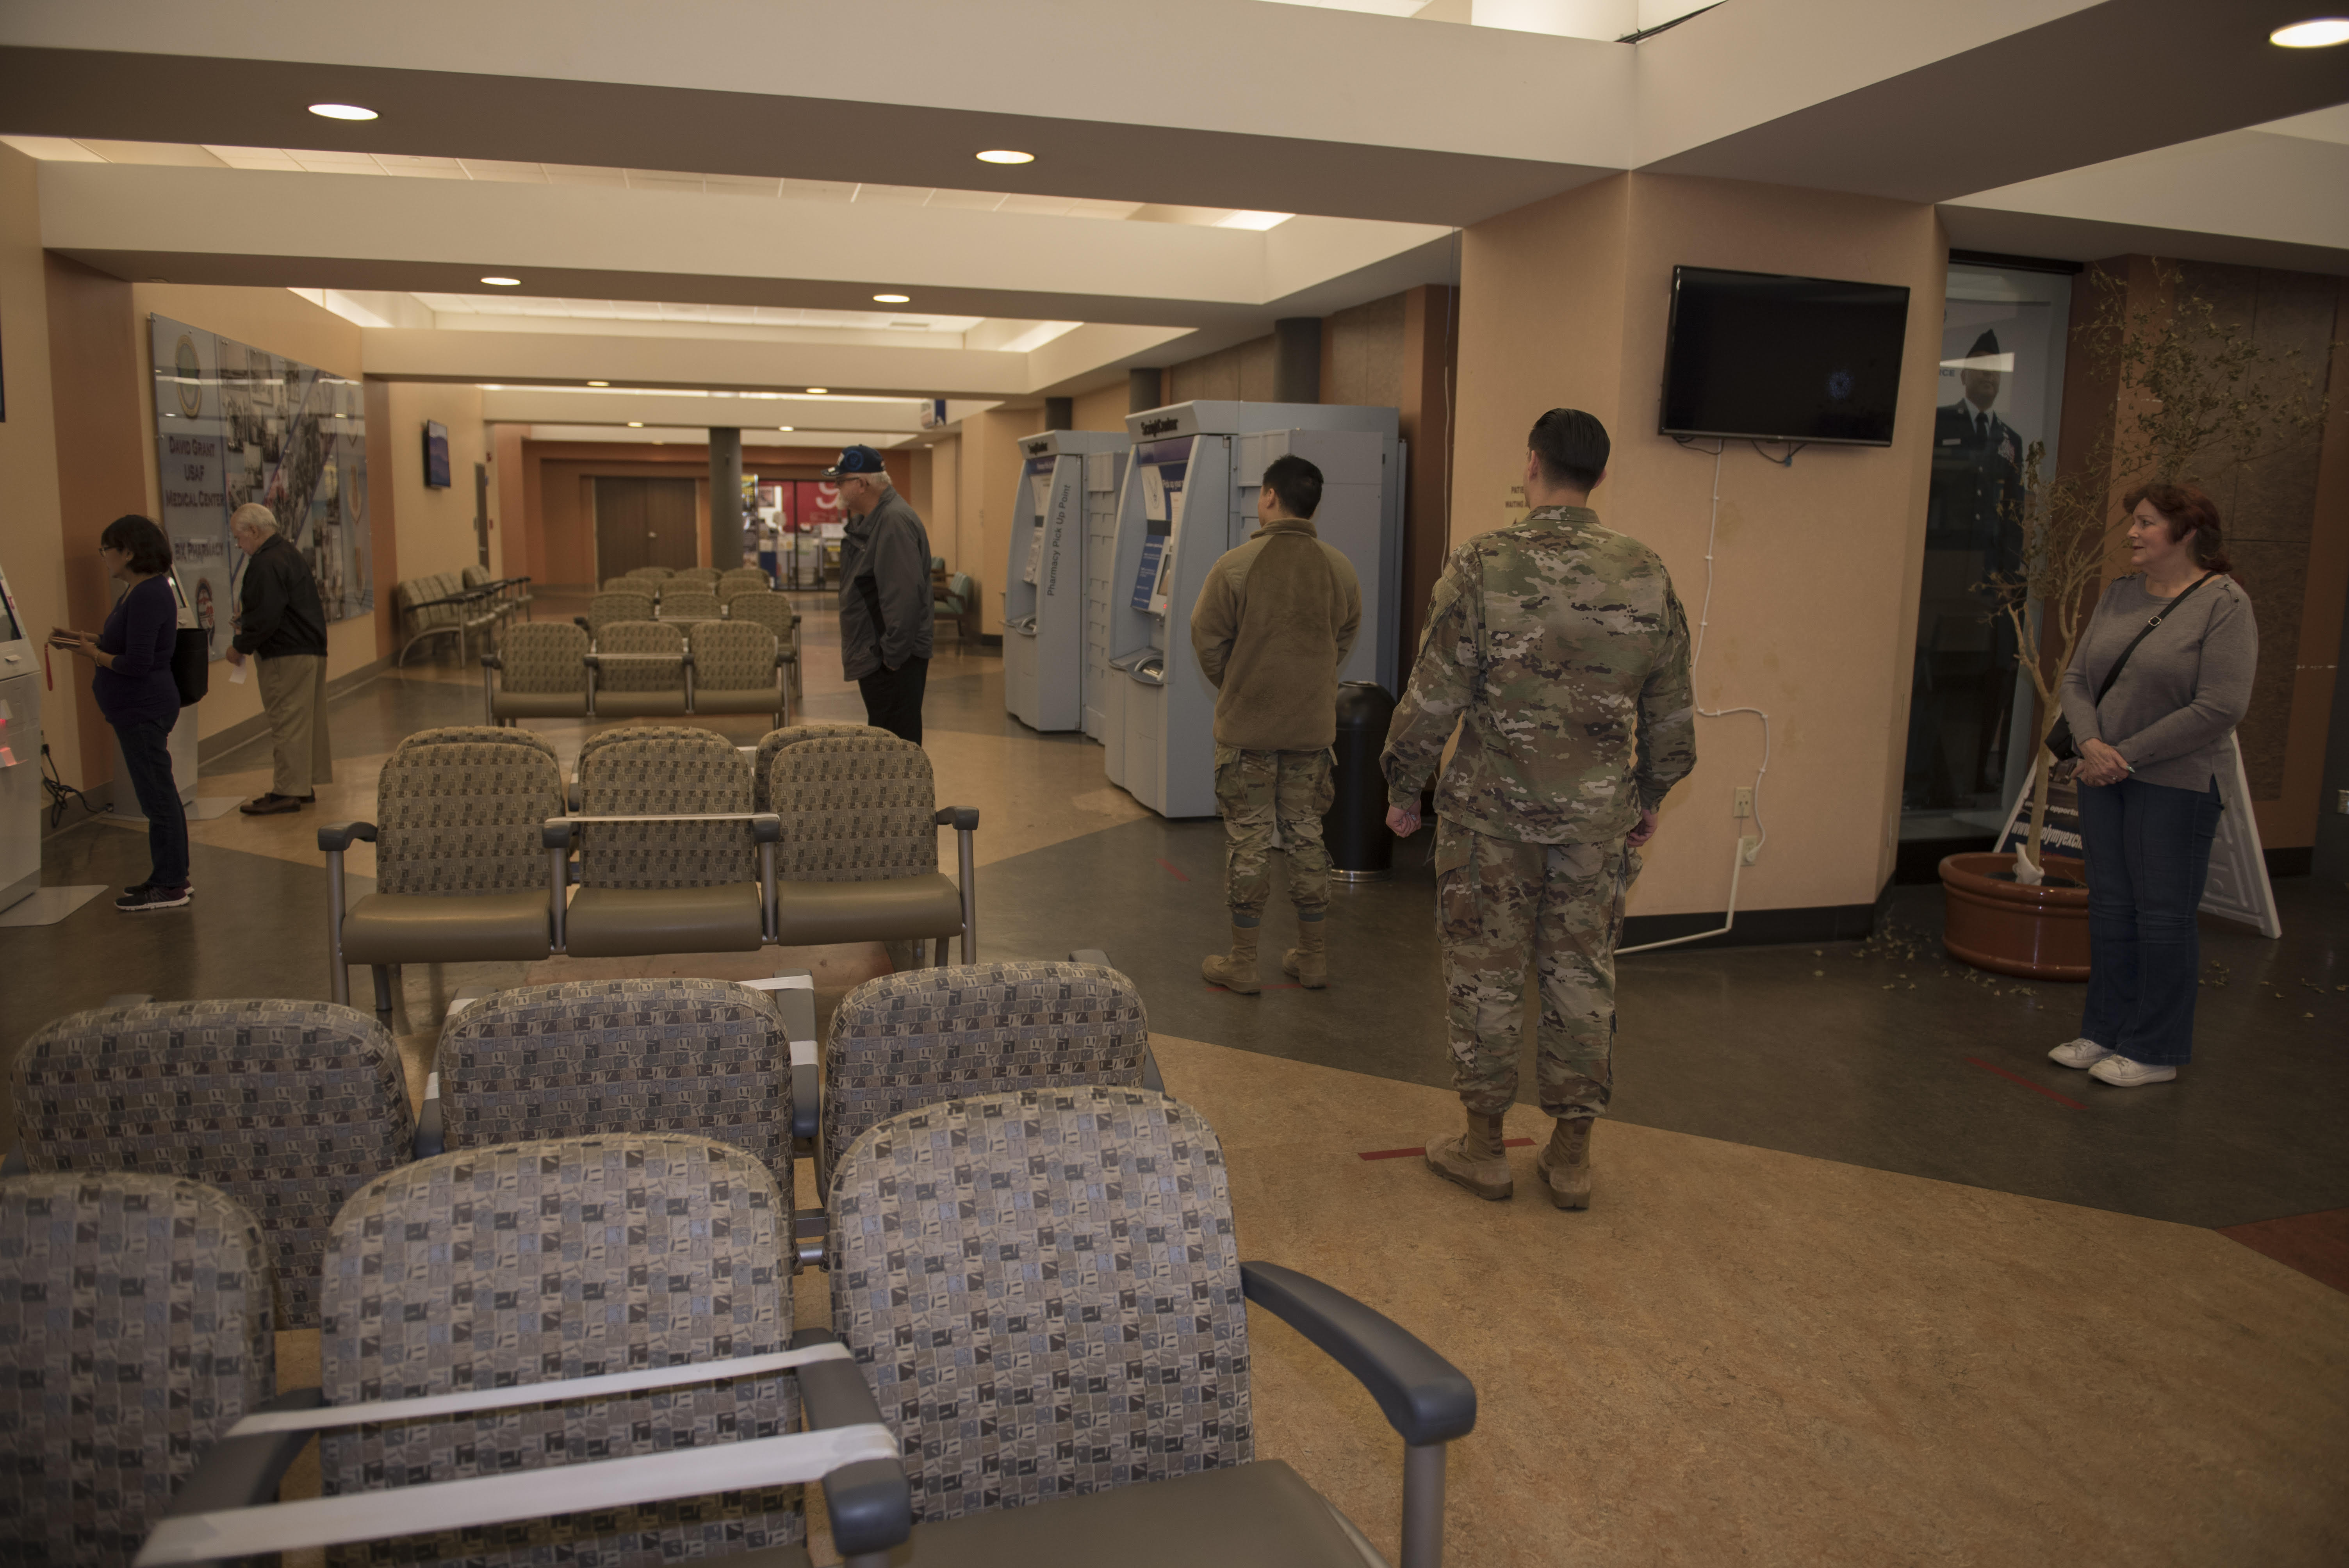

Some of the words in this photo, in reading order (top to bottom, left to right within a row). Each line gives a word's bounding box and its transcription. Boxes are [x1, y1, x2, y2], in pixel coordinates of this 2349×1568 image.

[184, 463, 204, 481] USAF
[166, 490, 198, 507] MEDICAL
[1059, 485, 1071, 509] Point
[1056, 512, 1066, 524] Up
[1053, 528, 1062, 547] Pick
[1047, 551, 1060, 596] Pharmacy
[2050, 805, 2079, 817] opportu
